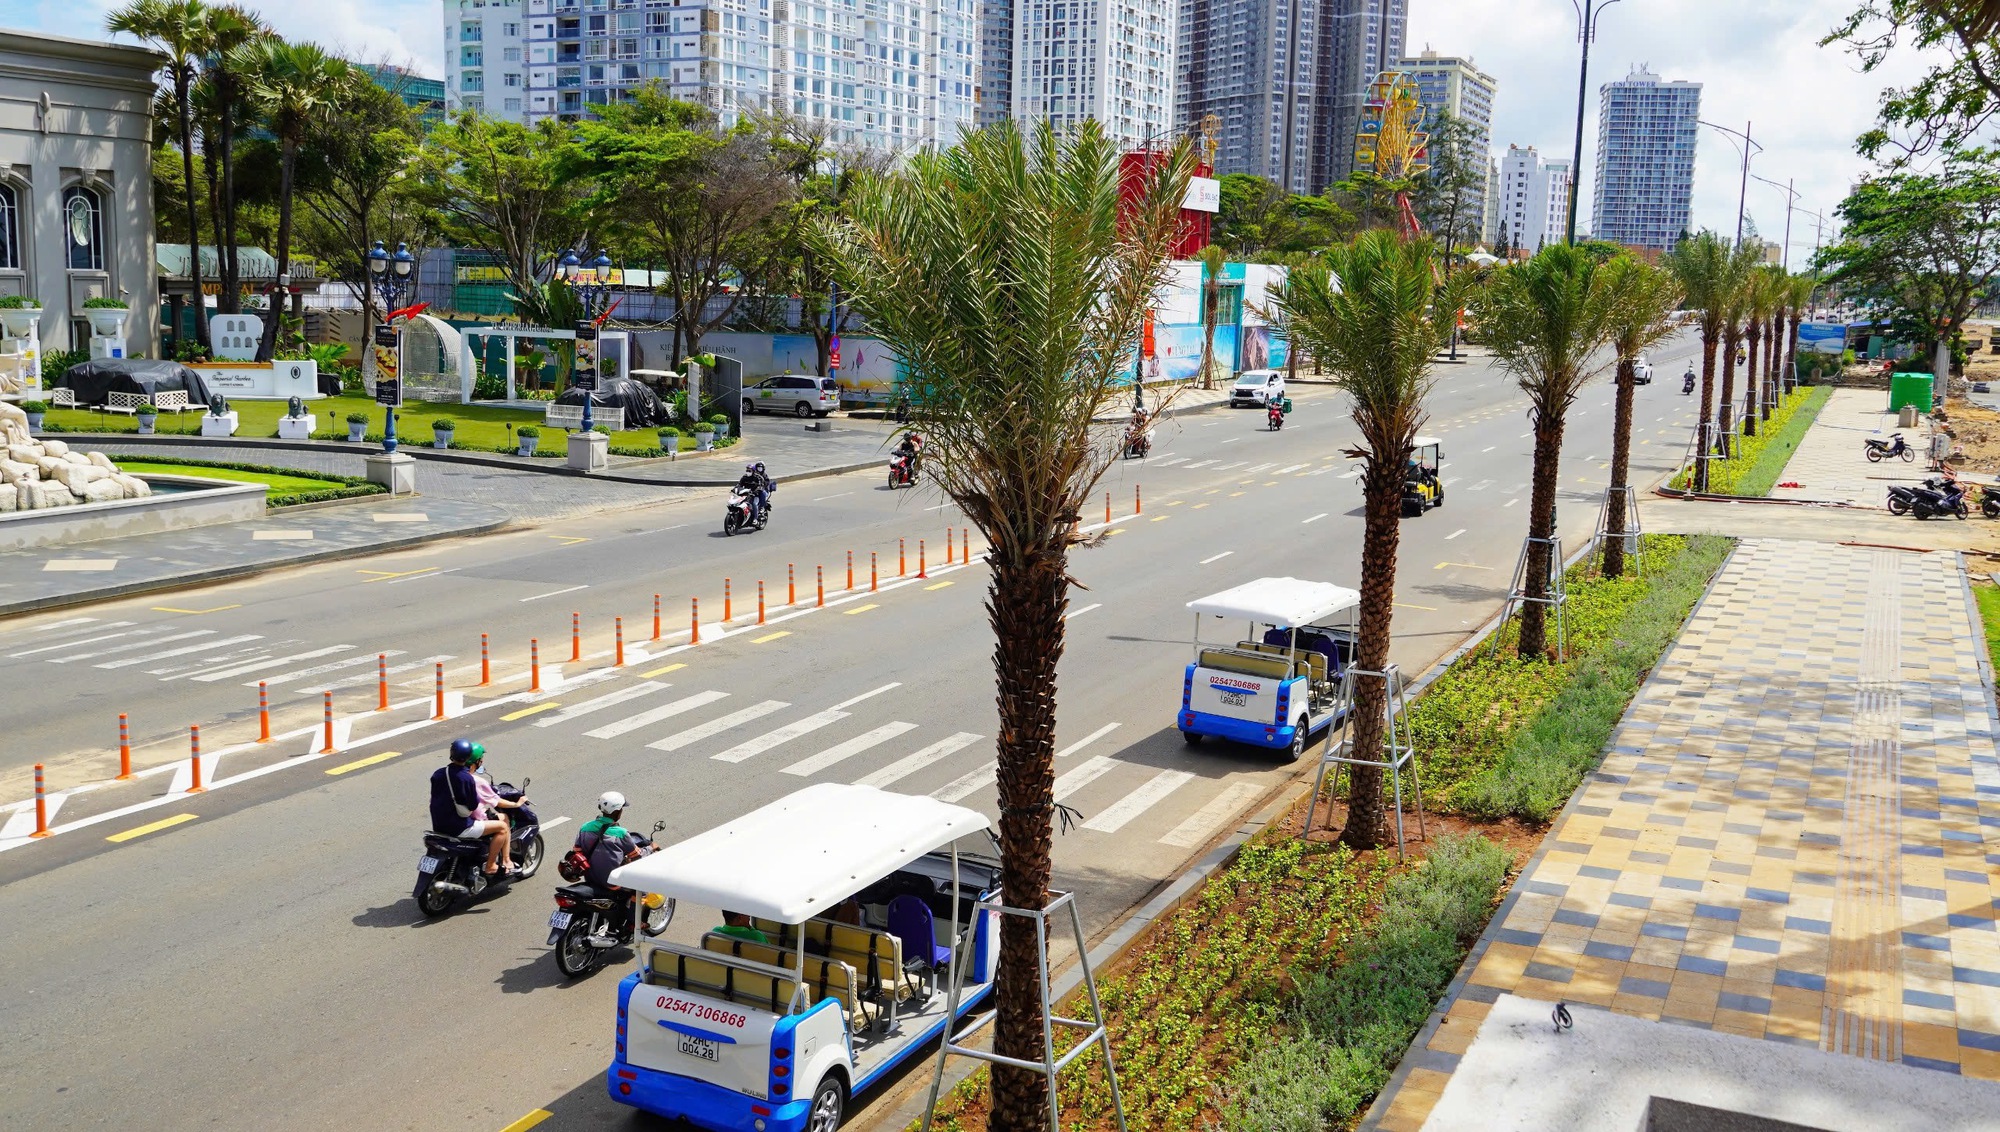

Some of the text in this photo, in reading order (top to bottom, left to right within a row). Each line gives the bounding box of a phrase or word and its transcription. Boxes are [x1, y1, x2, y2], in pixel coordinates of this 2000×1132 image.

[287, 258, 316, 279] Hotel
[1209, 676, 1261, 691] 02547306868
[656, 996, 746, 1028] 02547306868
[682, 1042, 714, 1059] 004.28
